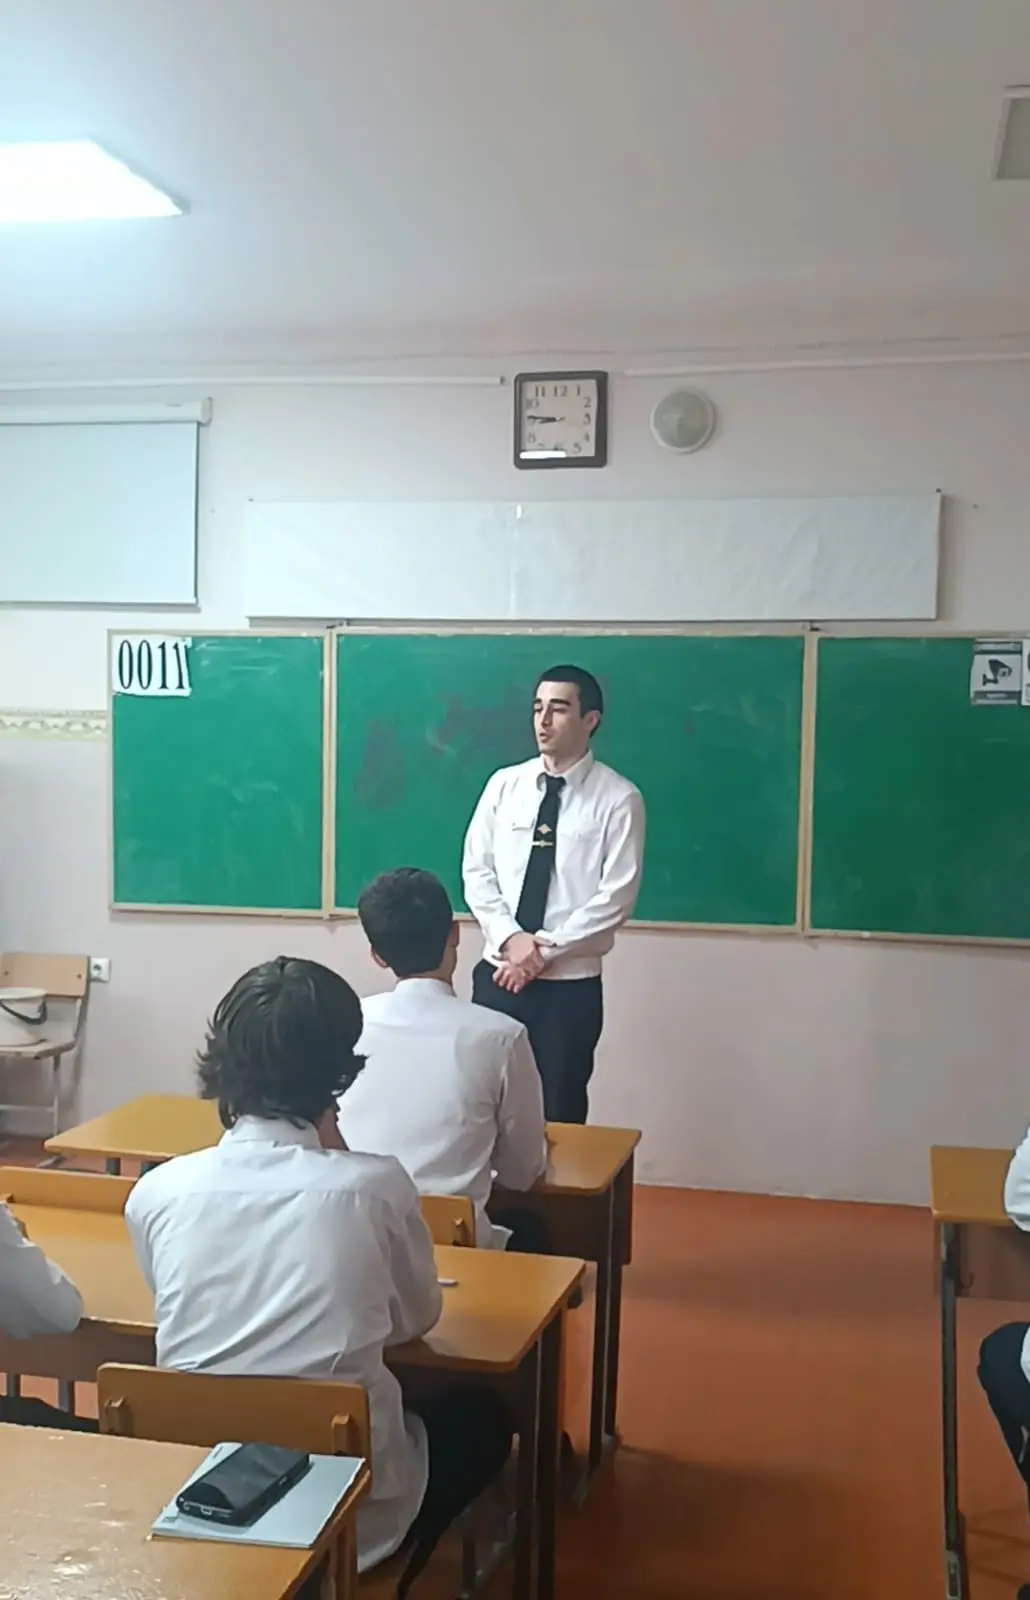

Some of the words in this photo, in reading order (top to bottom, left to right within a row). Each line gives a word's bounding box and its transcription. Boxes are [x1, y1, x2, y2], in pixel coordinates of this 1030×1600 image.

[535, 385, 545, 397] 11
[553, 385, 567, 397] 12
[576, 384, 581, 396] 1
[583, 396, 591, 408] 2
[583, 412, 591, 425] 3
